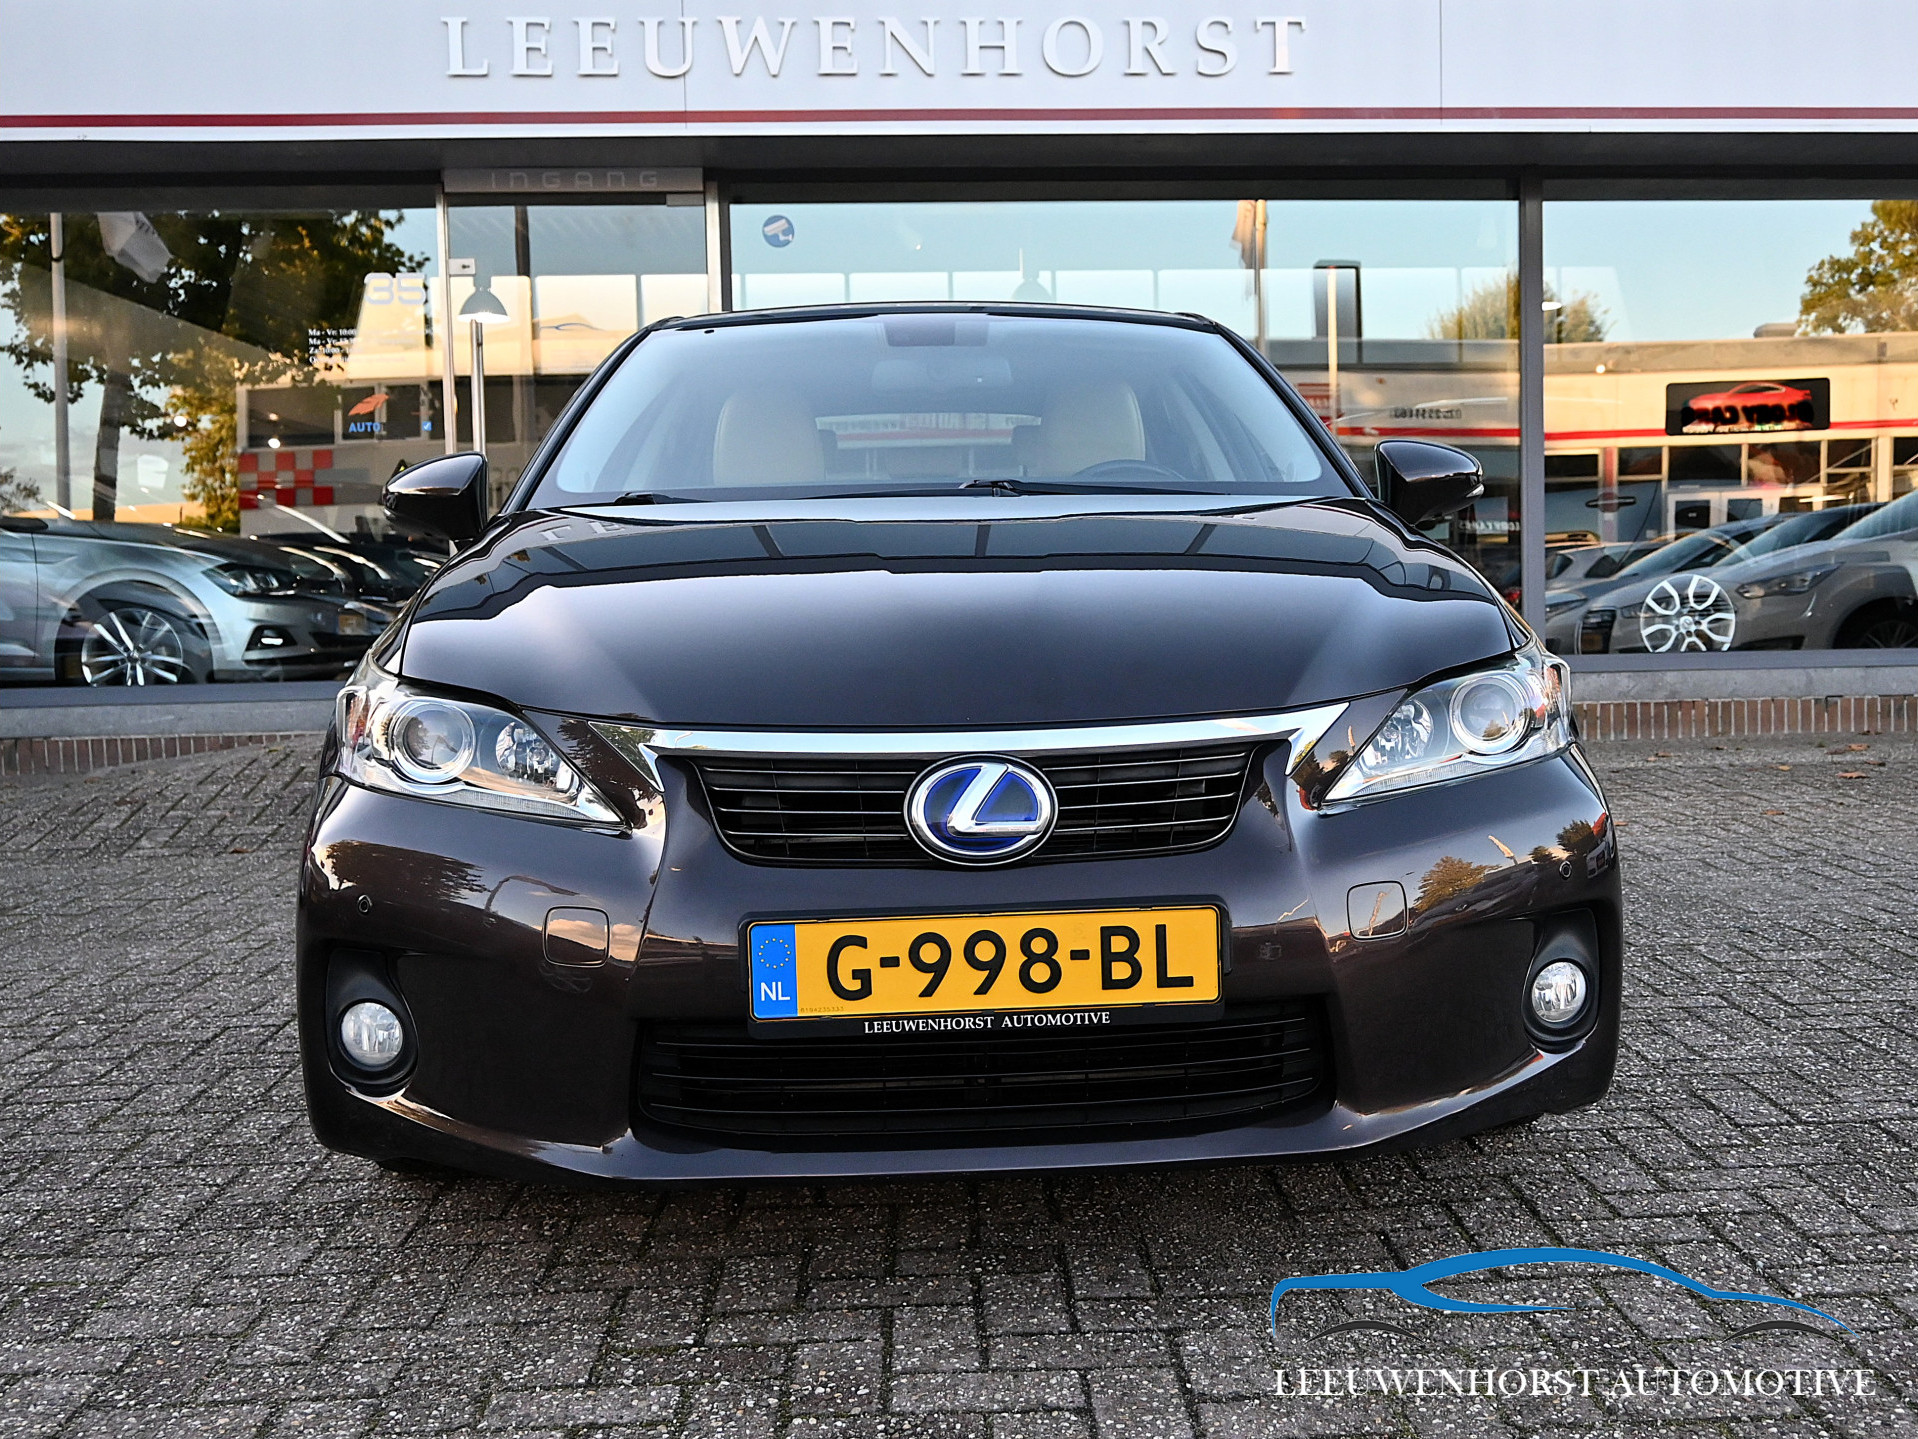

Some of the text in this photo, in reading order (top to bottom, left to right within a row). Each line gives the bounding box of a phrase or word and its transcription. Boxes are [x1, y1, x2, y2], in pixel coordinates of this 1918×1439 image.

[440, 15, 1307, 78] LEEUWENHORST
[364, 272, 427, 305] 35
[308, 328, 320, 336] Ma
[348, 422, 381, 433] AUTO
[826, 923, 1194, 1001] G-998-BL
[760, 982, 791, 1001] NL
[864, 1011, 1111, 1034] LEEUWENHORST AUTOMOTIVE
